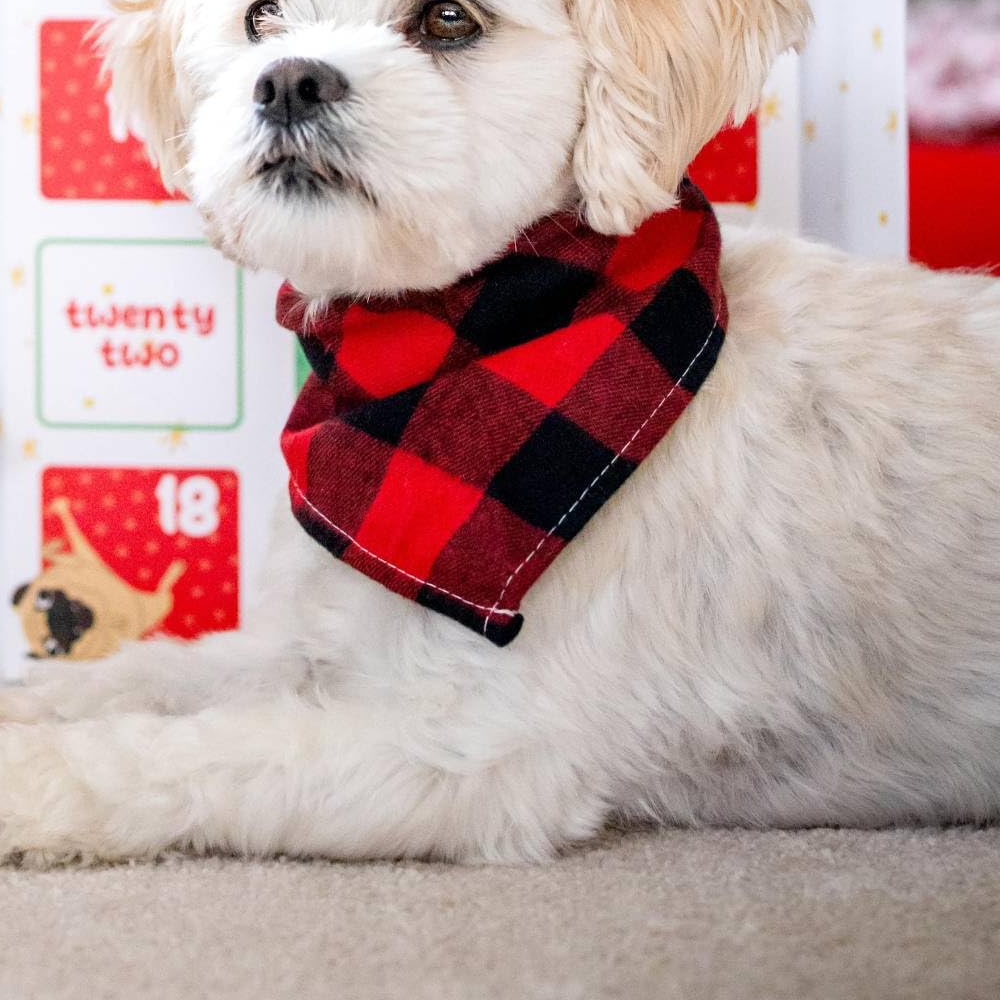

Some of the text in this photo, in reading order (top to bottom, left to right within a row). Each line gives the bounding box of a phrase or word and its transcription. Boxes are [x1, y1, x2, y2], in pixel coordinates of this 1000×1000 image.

[65, 301, 216, 336] twenty
[100, 340, 180, 368] two
[155, 473, 220, 537] 18
